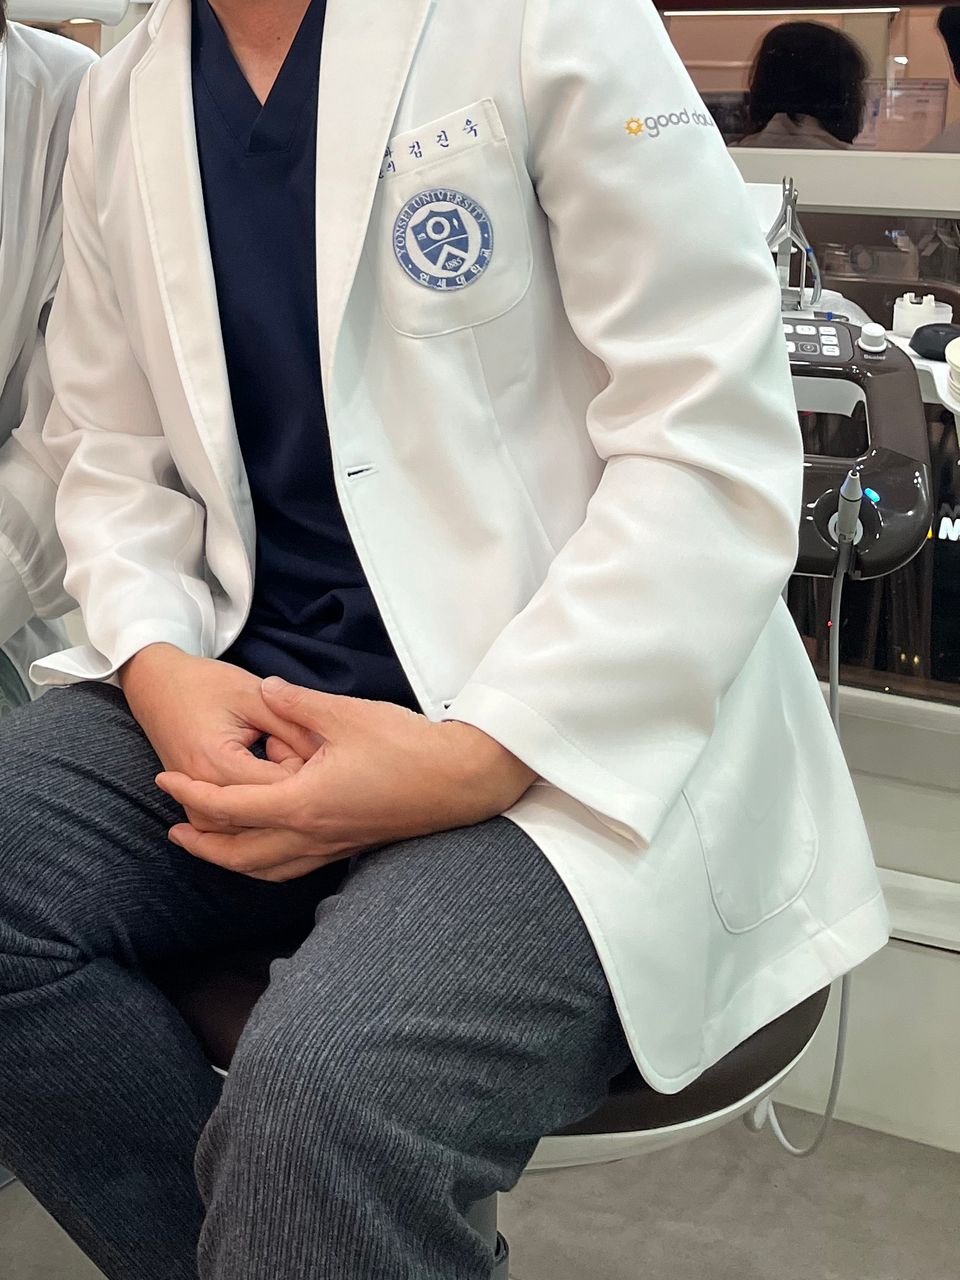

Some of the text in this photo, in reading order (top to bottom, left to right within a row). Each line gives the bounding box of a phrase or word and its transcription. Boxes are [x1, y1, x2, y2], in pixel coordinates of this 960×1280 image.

[644, 107, 690, 138] good
[395, 189, 487, 257] YONSEI UNIVERSITY
